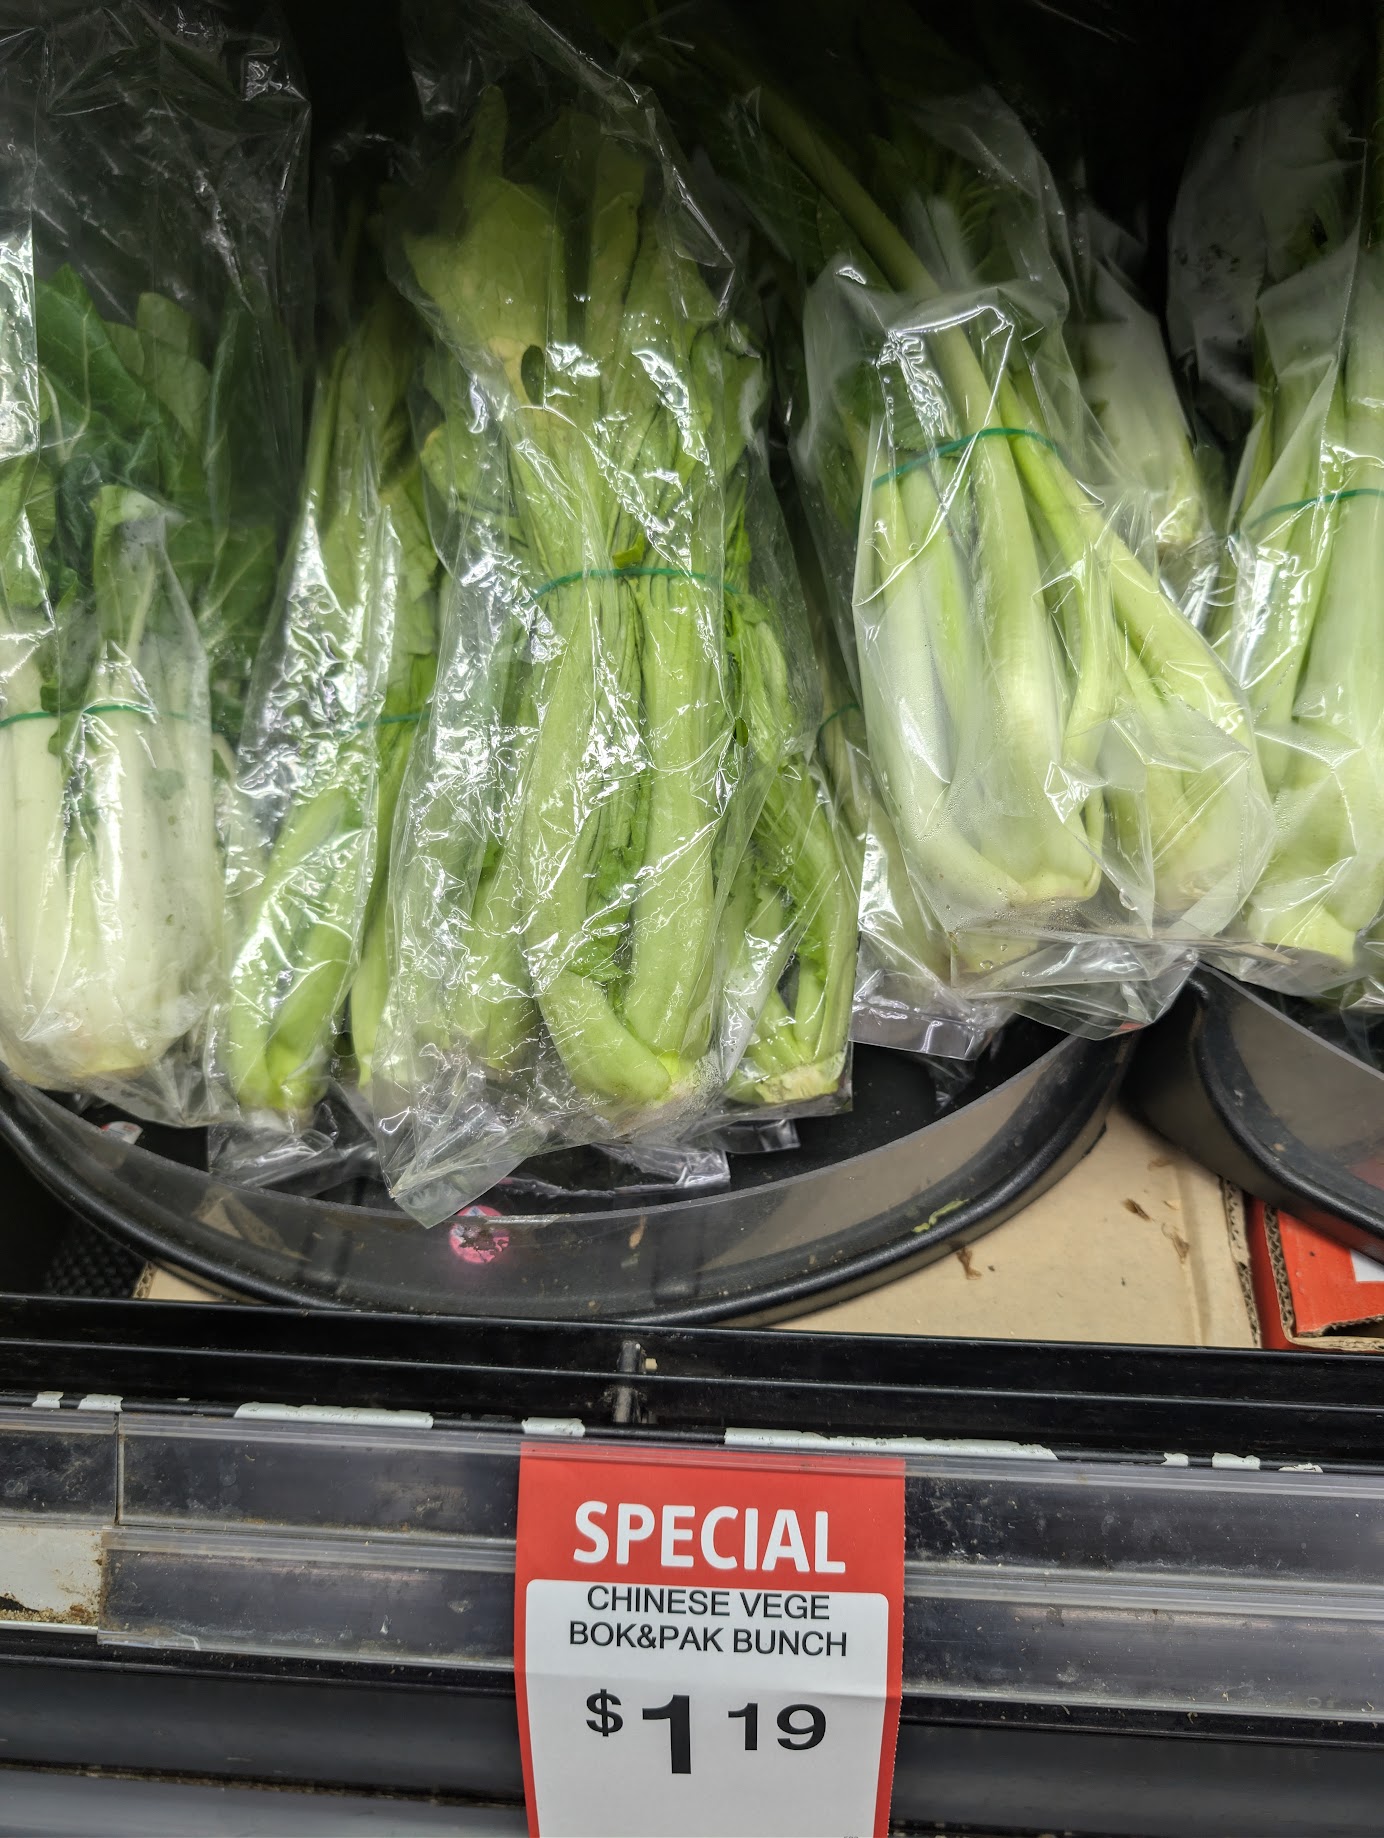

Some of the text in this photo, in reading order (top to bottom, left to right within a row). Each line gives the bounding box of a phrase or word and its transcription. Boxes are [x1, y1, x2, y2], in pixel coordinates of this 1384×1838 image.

[573, 1500, 846, 1573] SPECIAL
[586, 1585, 830, 1620] CHINESE VEGE
[569, 1621, 848, 1657] BOK&PAK BUNCH
